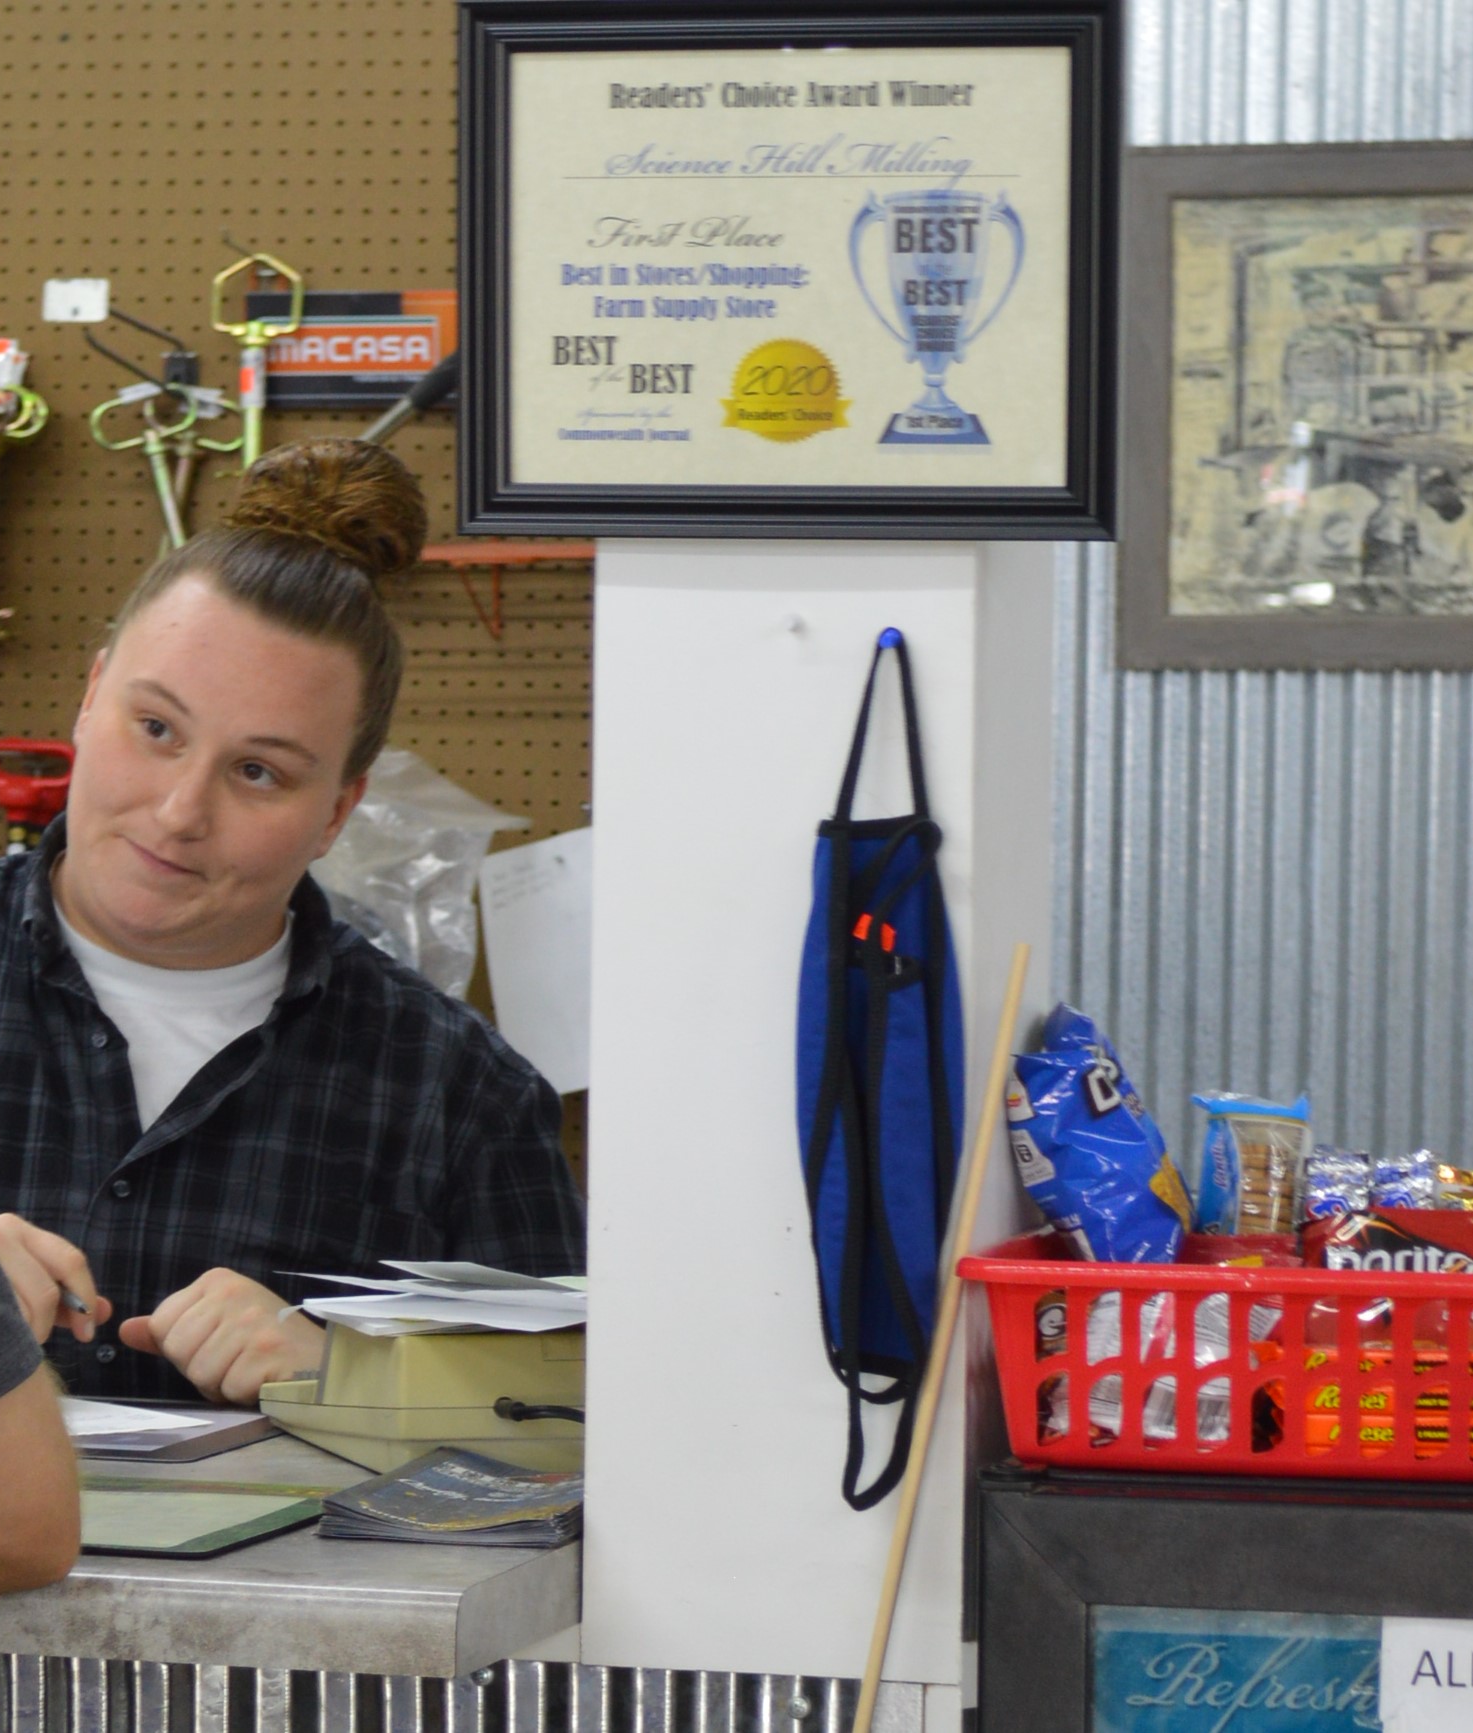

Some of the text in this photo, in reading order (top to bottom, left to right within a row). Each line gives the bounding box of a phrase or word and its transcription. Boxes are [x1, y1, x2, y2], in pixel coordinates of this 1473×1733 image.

[609, 80, 975, 109] Readers' Choice Award Winner
[606, 133, 975, 190] Science Hill Milling
[587, 215, 785, 248] First Place
[894, 218, 979, 253] BEST
[561, 264, 603, 286] Best
[609, 264, 629, 286] in
[904, 279, 968, 306] BEST
[594, 296, 776, 321] Farm Supply Store
[552, 336, 618, 366] BEST
[629, 364, 694, 394] BEST
[741, 366, 832, 396] 2020
[793, 409, 834, 422] Choice
[1410, 1649, 1473, 1688] AL
